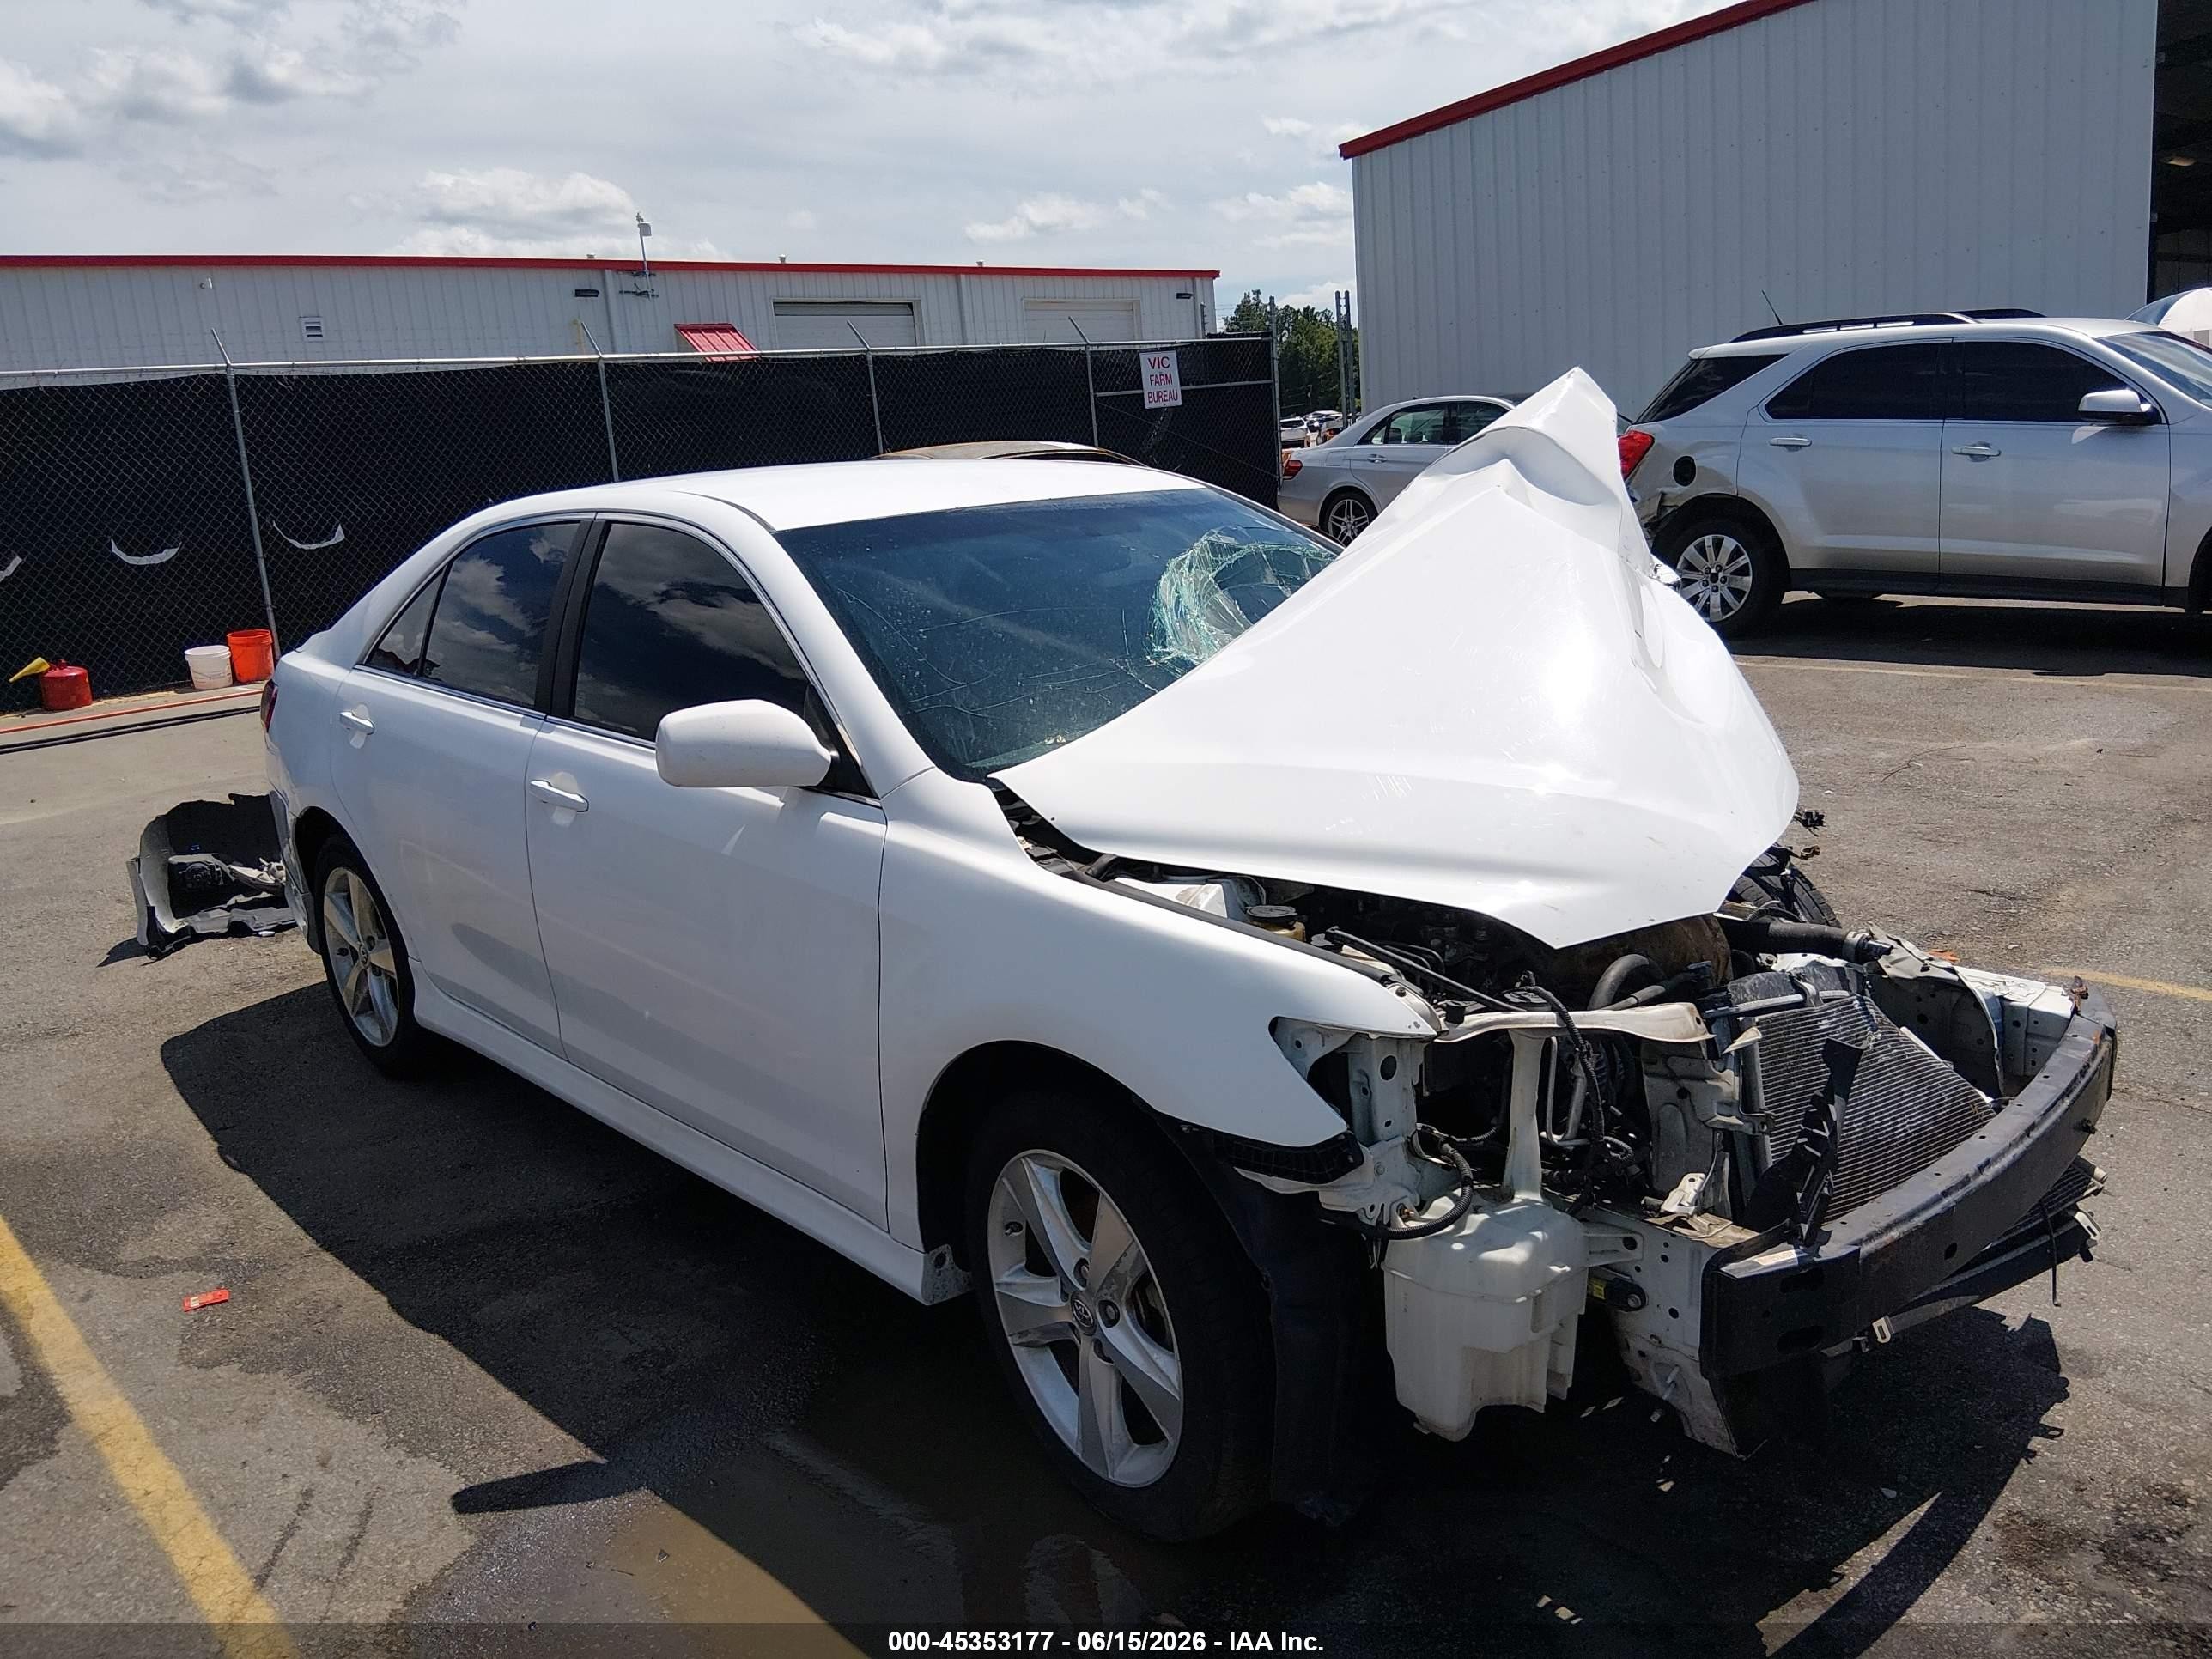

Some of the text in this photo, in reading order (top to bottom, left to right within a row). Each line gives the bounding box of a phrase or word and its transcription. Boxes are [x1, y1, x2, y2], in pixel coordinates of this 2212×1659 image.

[1147, 356, 1170, 369] VIC
[1149, 373, 1173, 386] FARM
[1147, 389, 1178, 404] BUREAU
